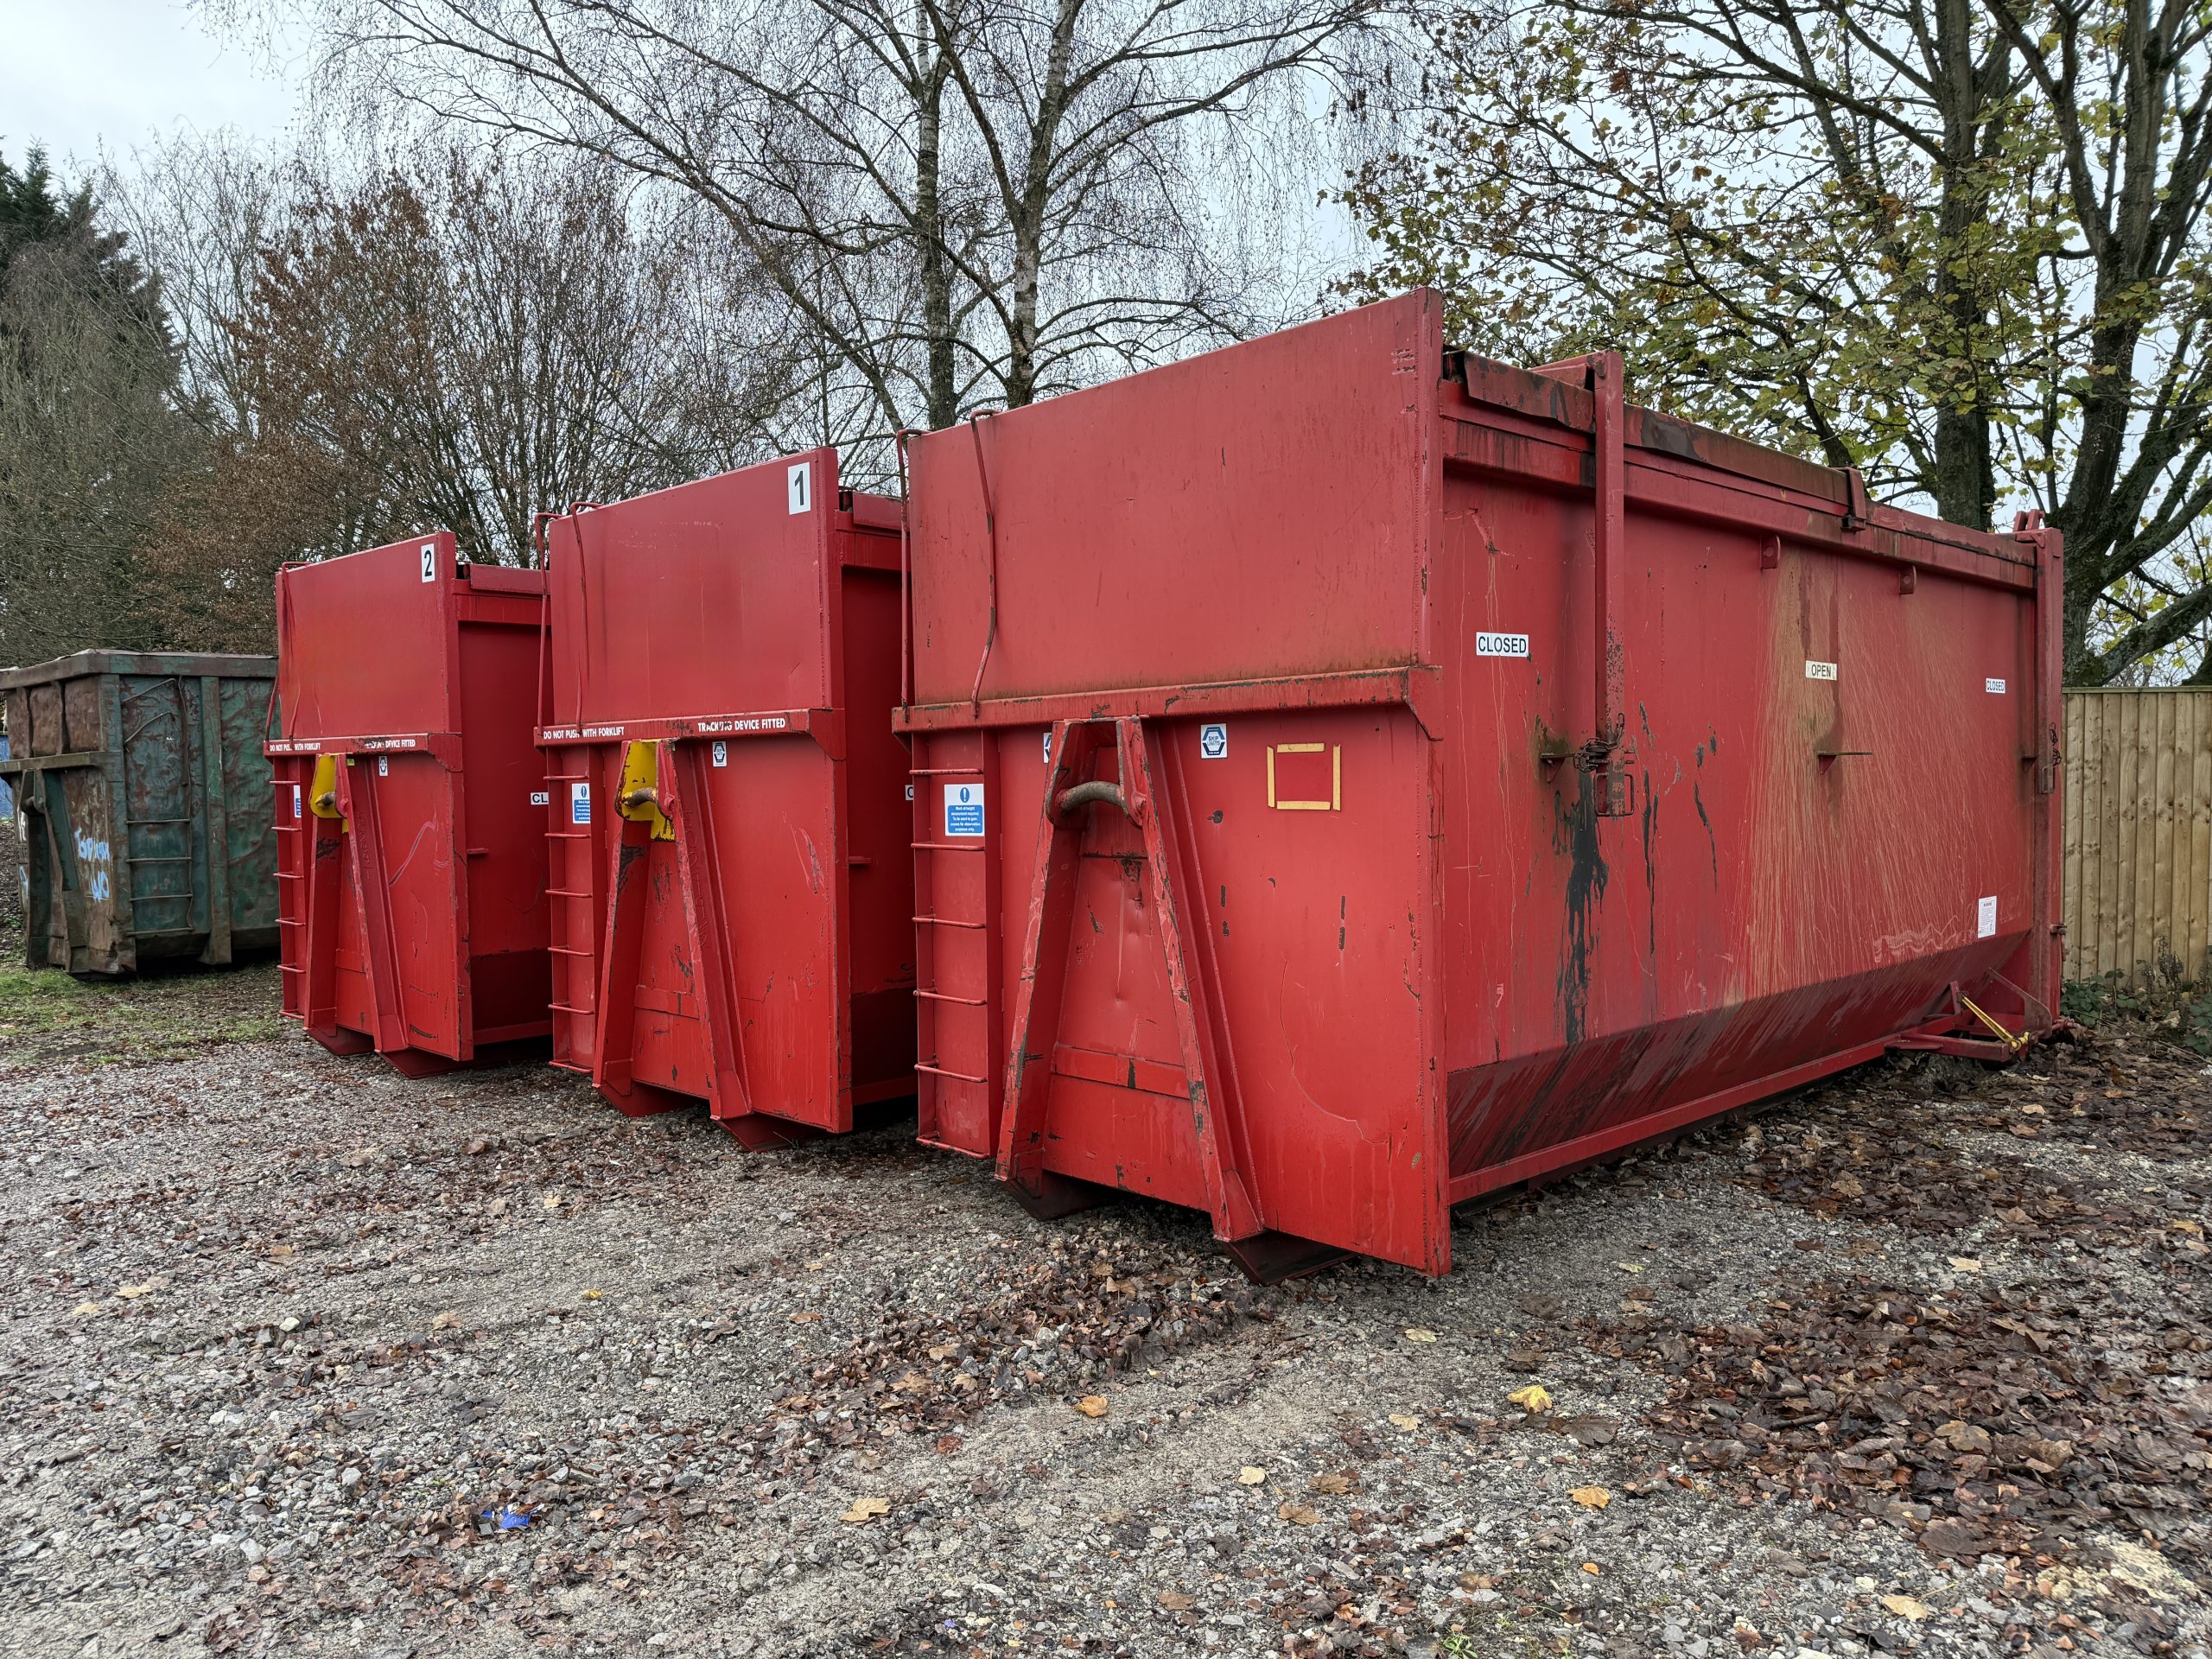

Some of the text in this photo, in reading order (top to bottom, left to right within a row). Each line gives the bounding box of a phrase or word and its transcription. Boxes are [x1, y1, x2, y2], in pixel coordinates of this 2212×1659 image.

[794, 470, 804, 506] 1
[424, 550, 433, 577] 2
[1478, 635, 1527, 654] CLOSED
[1811, 664, 1832, 677] OPEN
[1986, 680, 2005, 691] CLOSED
[734, 719, 760, 731] DEVICE
[761, 717, 786, 728] FITTED
[543, 731, 552, 740] DO
[553, 730, 564, 740] NOT
[582, 728, 597, 738] WITH
[598, 726, 625, 736] FORKLIFT
[532, 793, 548, 804] CL
